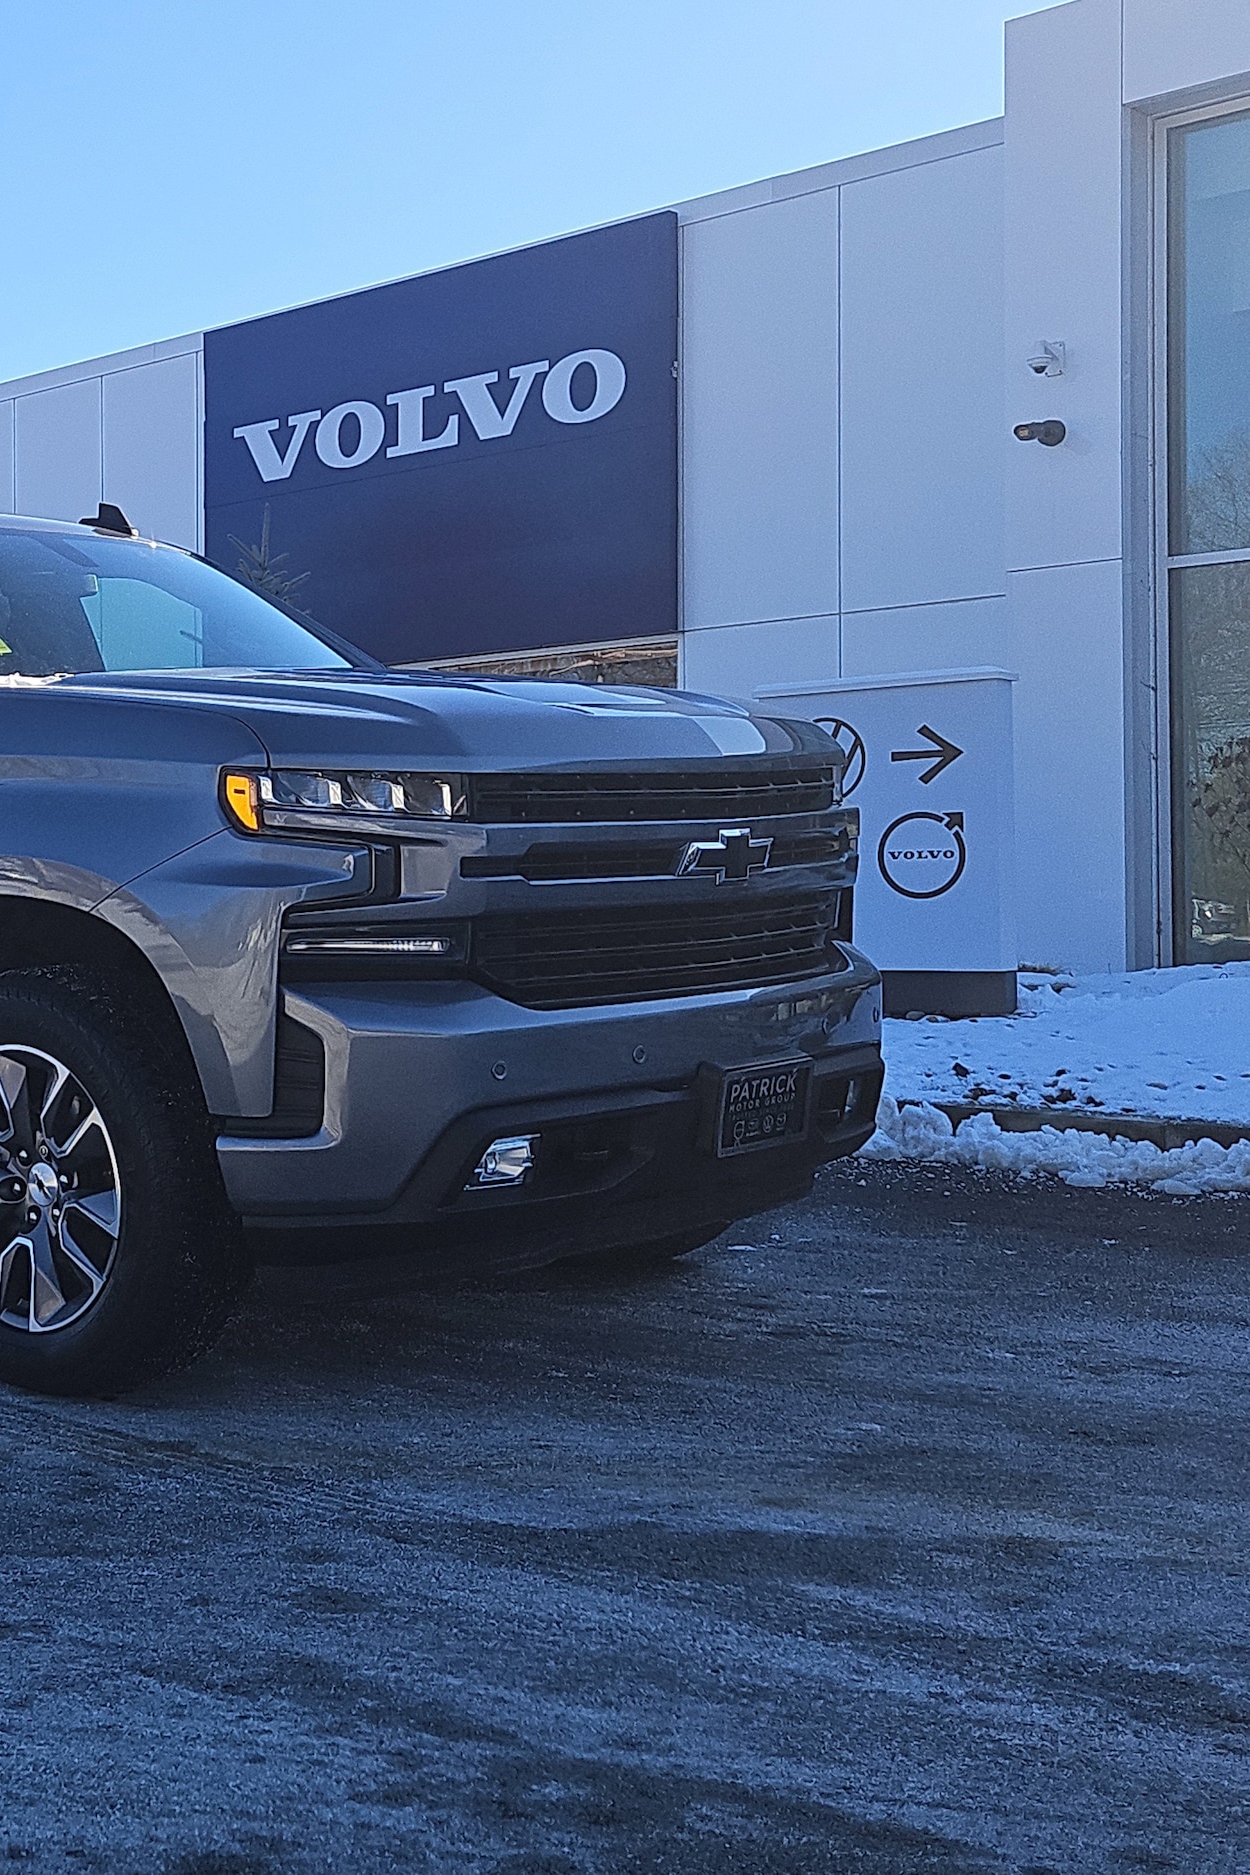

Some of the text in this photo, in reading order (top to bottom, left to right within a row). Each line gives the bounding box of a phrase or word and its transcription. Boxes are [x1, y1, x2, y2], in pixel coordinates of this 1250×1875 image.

[233, 348, 626, 482] VOLVO
[888, 849, 955, 860] VOLVO
[730, 1074, 797, 1103] PATRICK
[729, 1098, 761, 1113] MOTOR
[764, 1093, 796, 1106] GROUP
